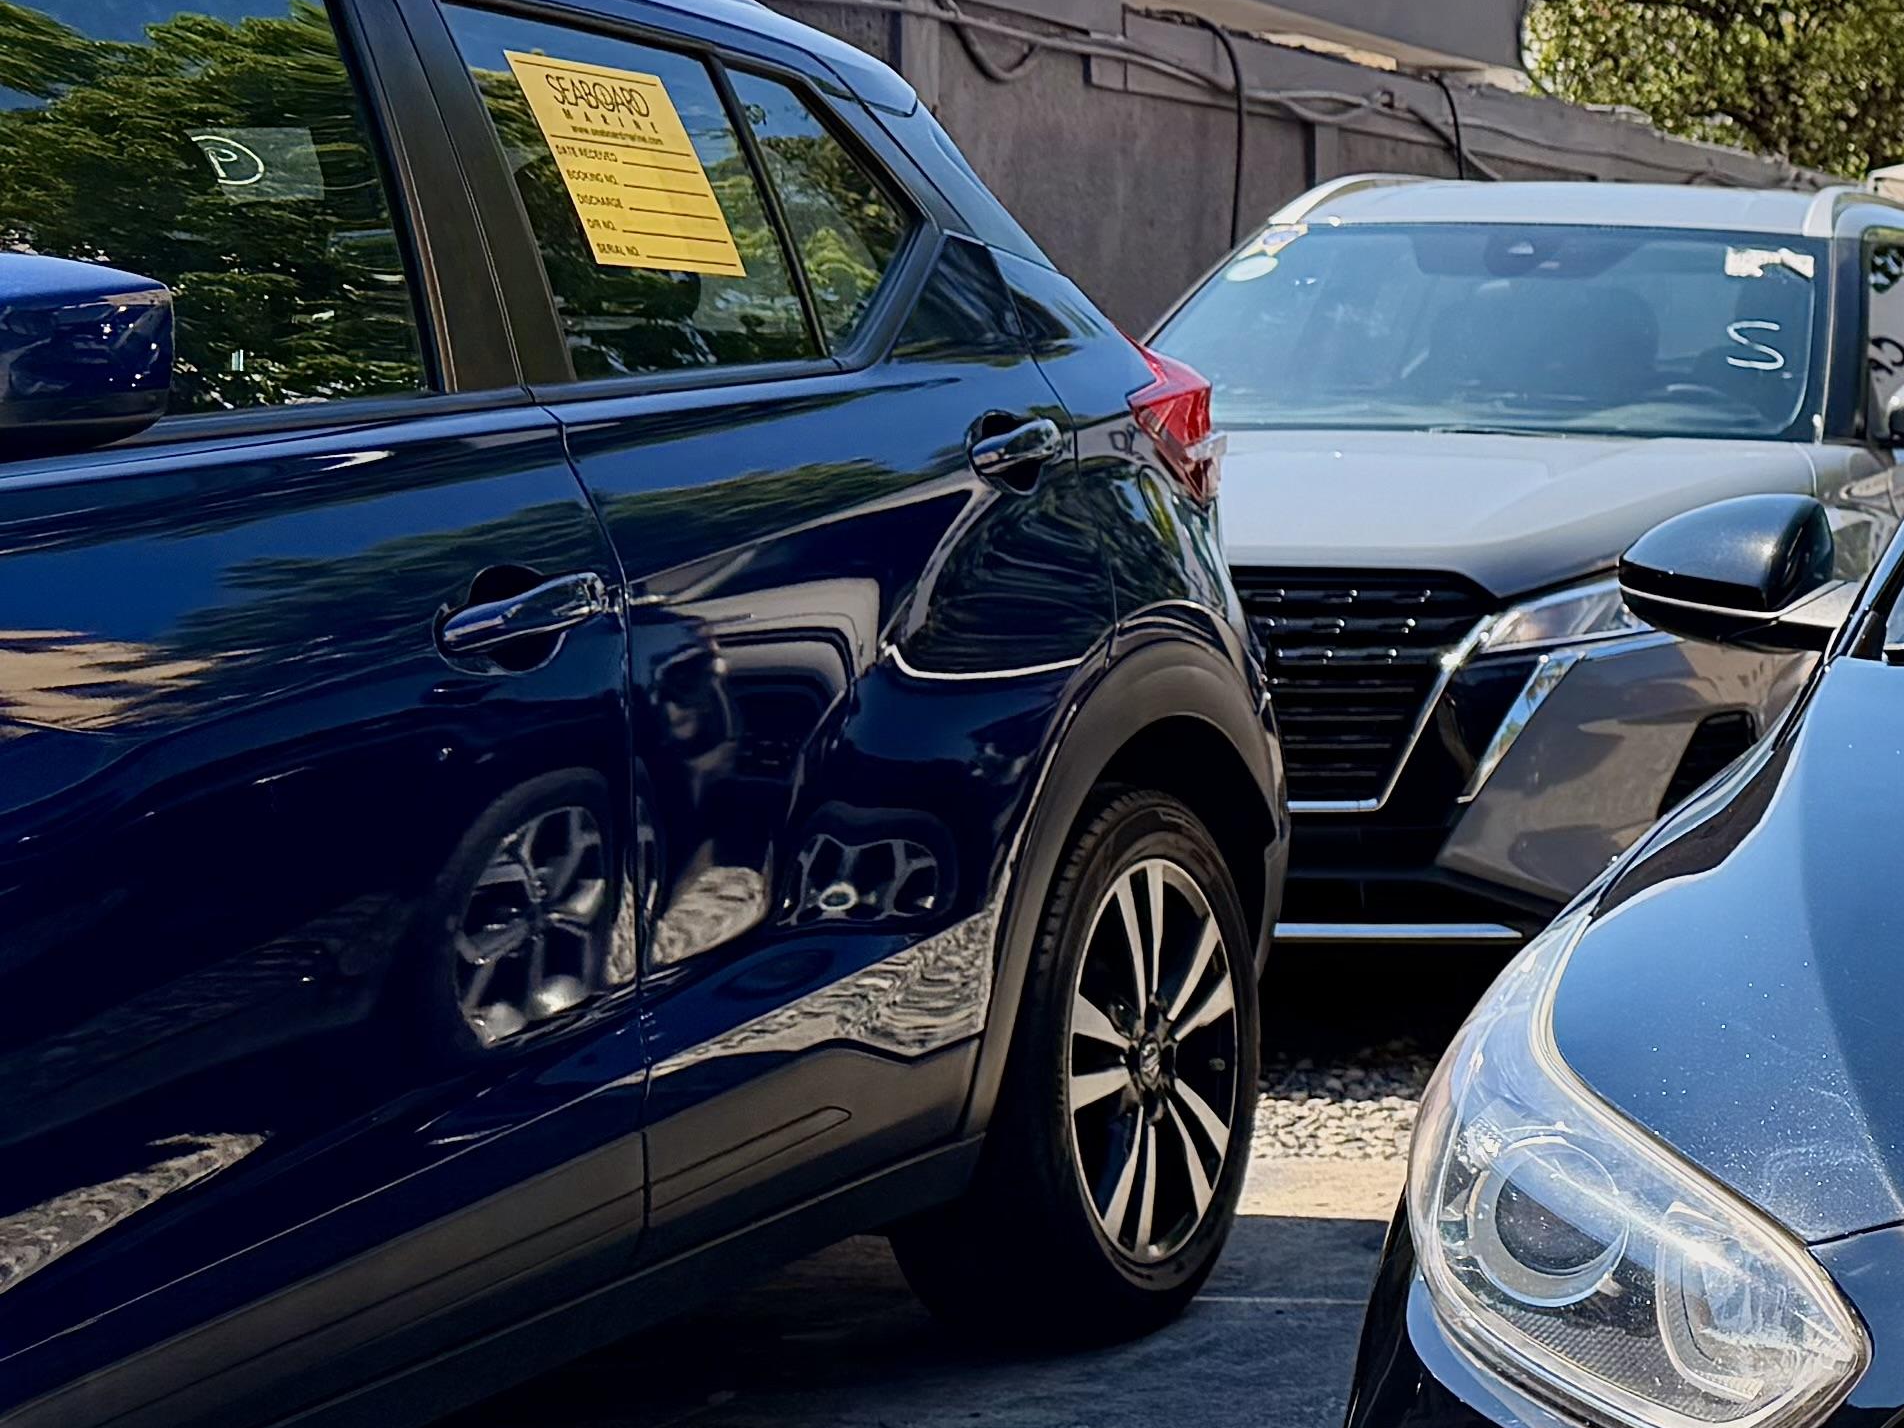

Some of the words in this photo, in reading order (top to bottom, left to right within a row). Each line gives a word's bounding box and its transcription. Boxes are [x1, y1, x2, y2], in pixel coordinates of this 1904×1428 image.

[545, 73, 650, 118] SEABOARD
[562, 108, 659, 134] MARINE
[566, 169, 604, 183] BOOKING
[576, 193, 624, 209] DISCHARGE
[596, 242, 626, 256] SERIAL
